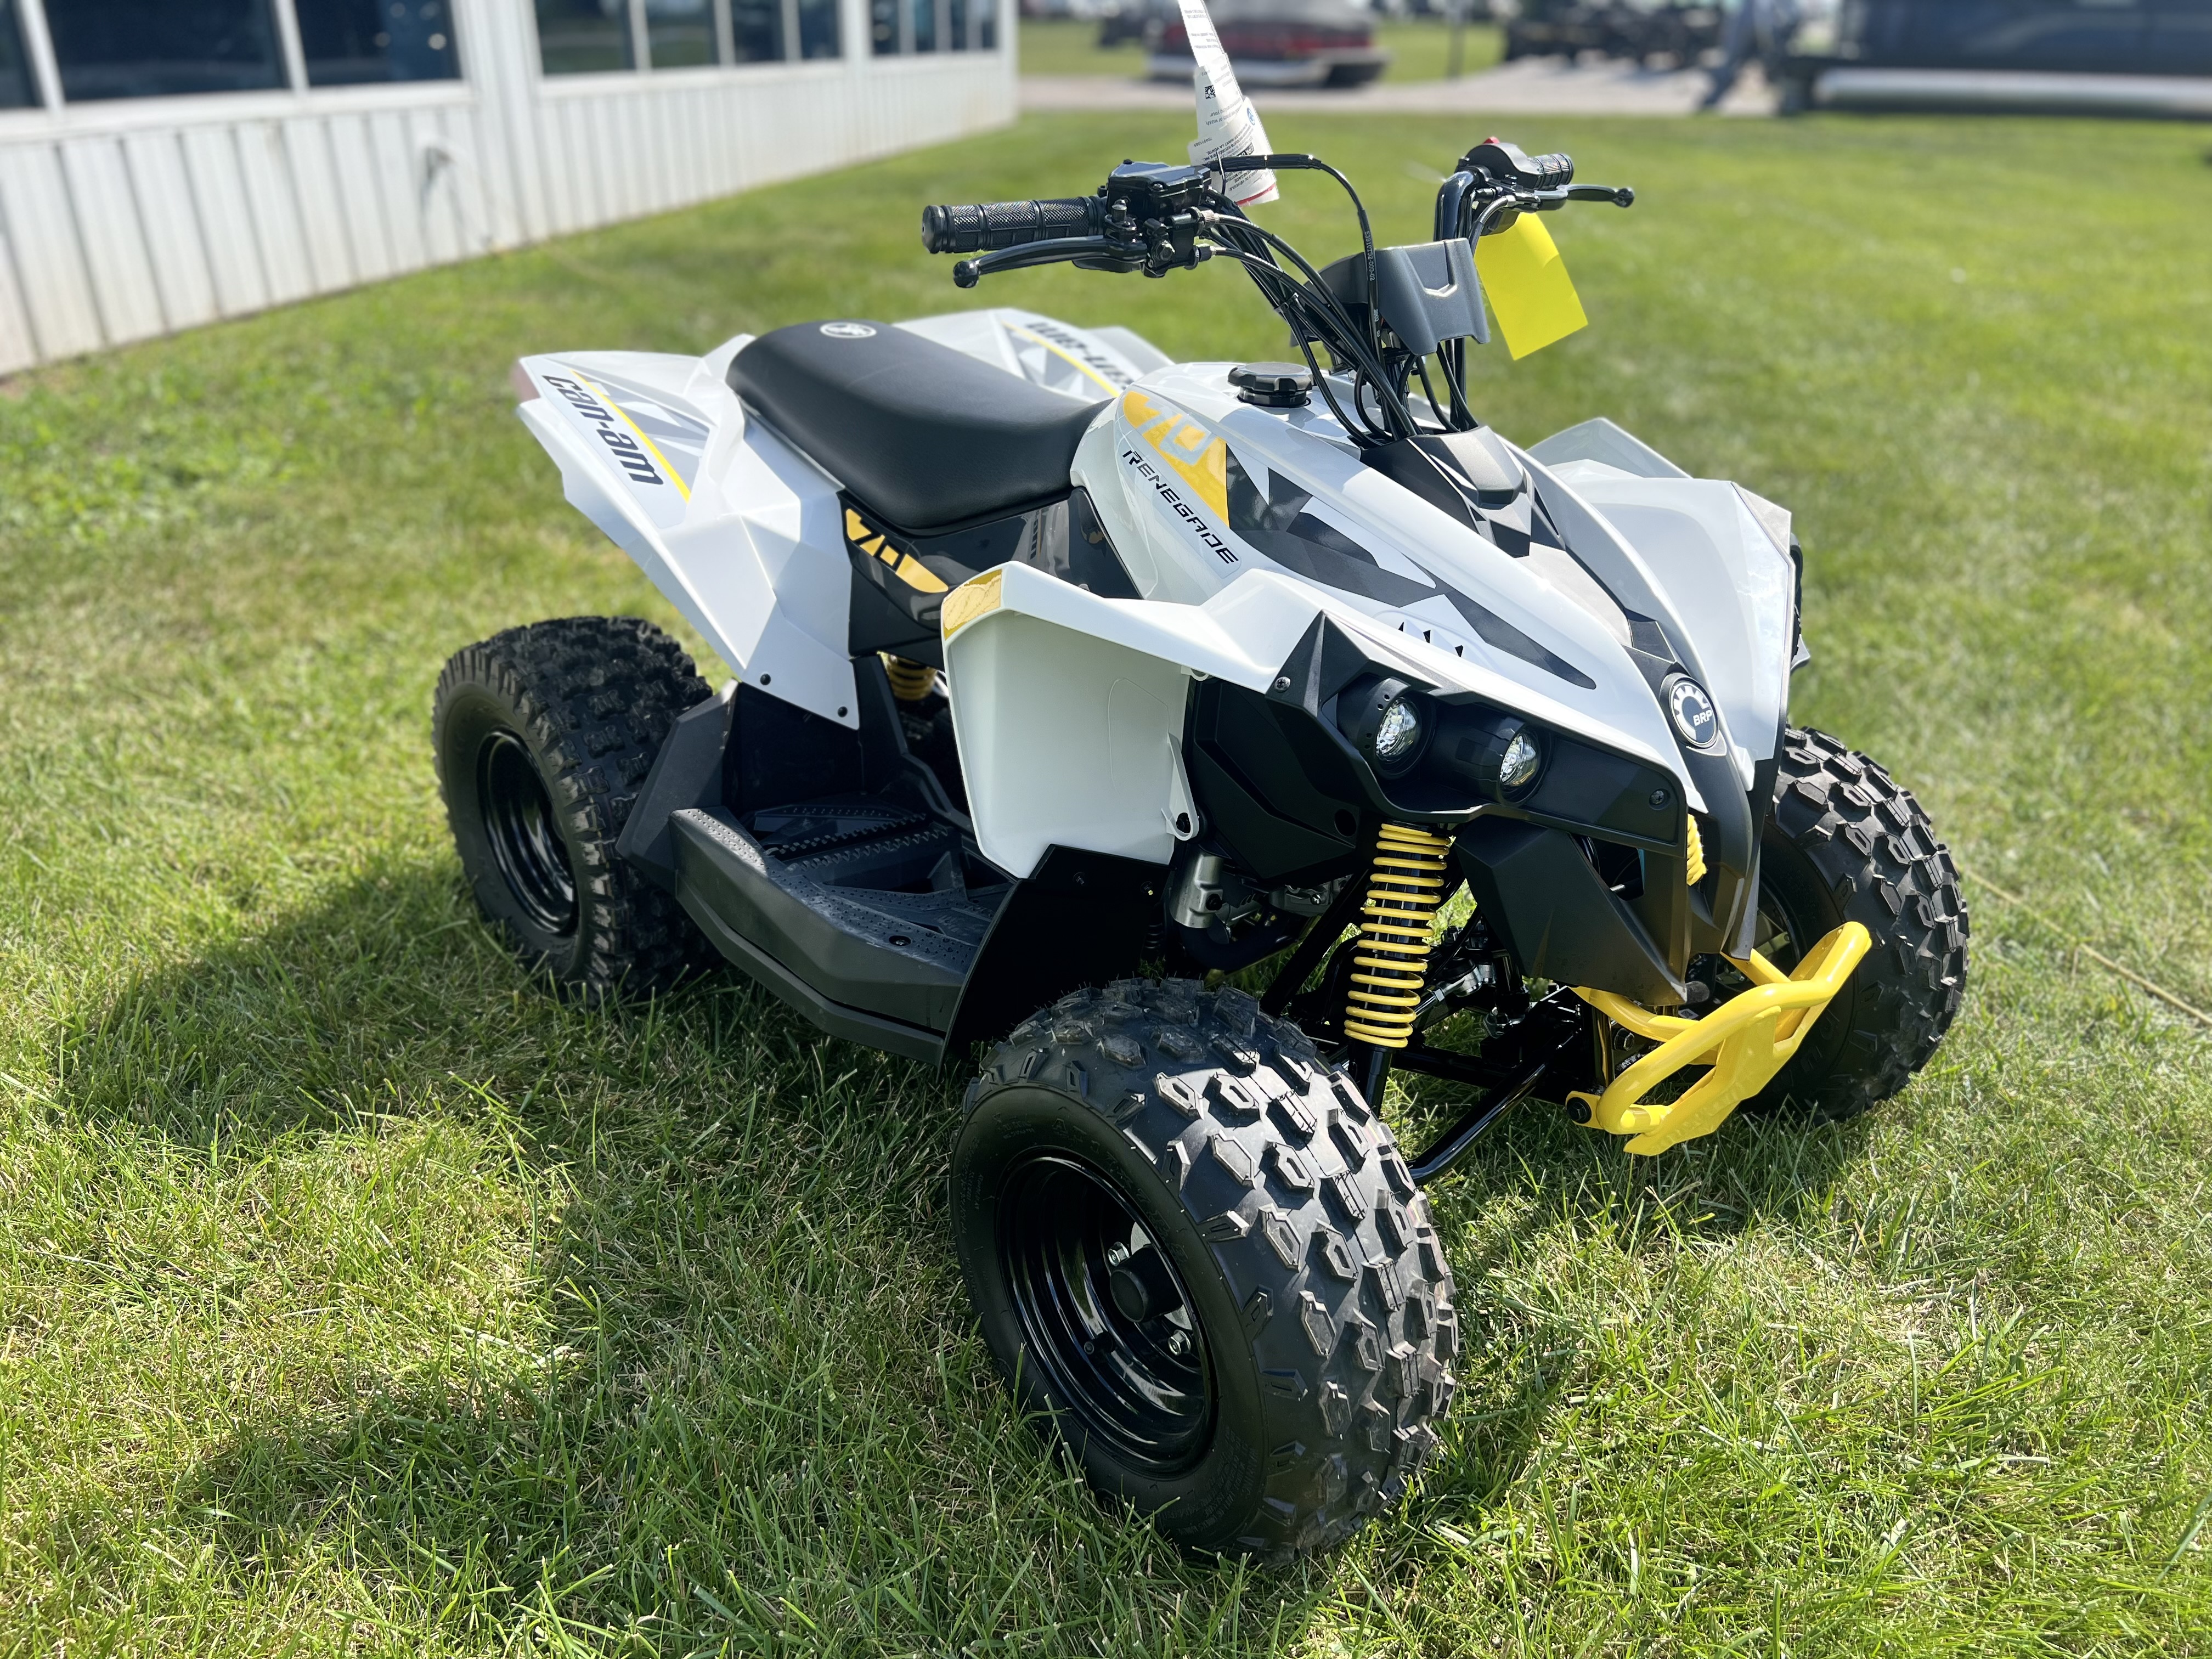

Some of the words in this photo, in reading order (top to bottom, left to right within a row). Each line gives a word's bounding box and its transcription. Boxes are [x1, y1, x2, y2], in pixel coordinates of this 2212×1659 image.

[1122, 450, 1239, 564] RENEGADE
[854, 518, 906, 572] 70
[1693, 709, 1713, 726] BRP
